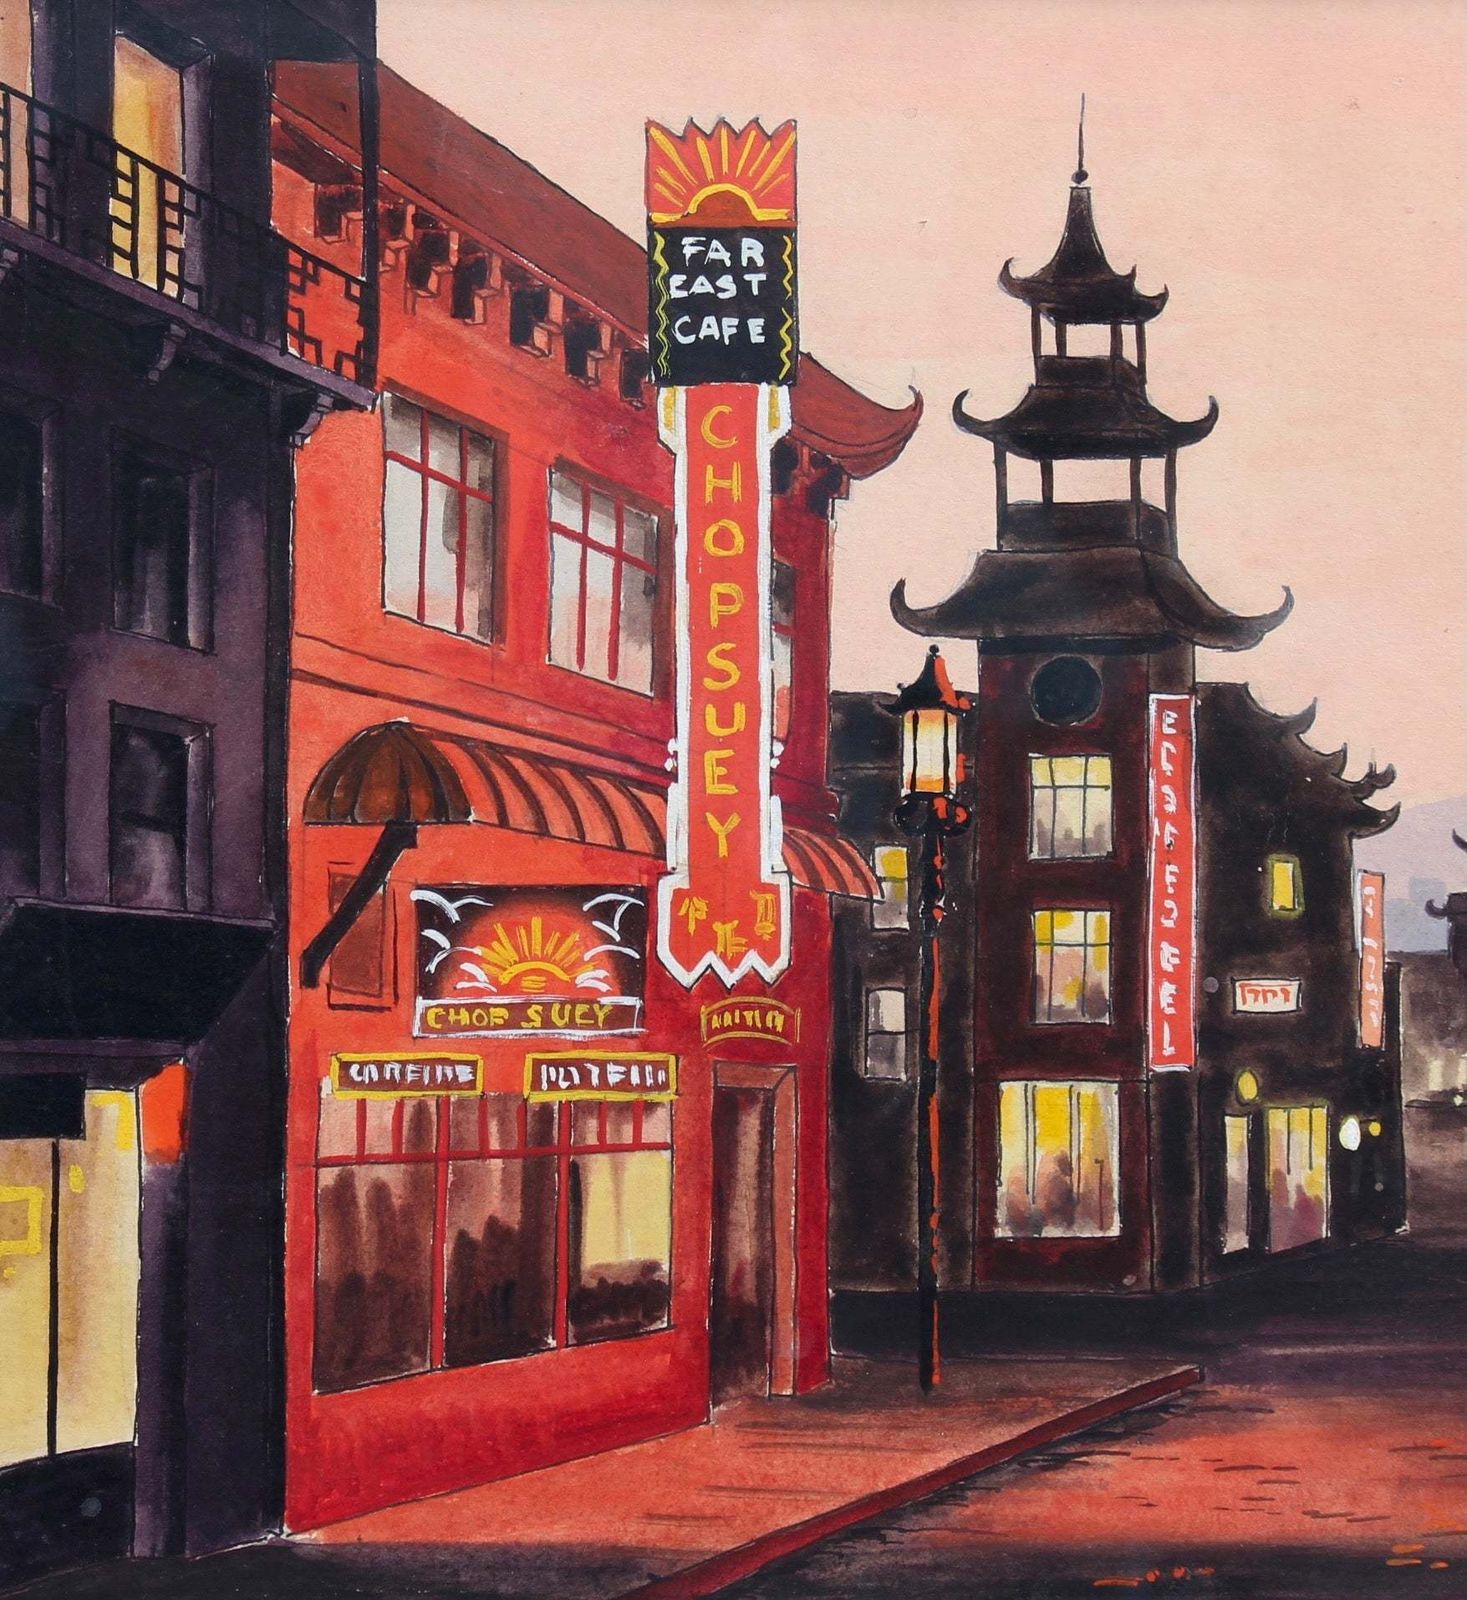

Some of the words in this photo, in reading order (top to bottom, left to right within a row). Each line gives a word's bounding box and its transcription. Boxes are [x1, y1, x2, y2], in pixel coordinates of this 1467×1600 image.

[681, 236, 765, 267] FAR
[668, 273, 767, 299] EAST
[672, 315, 766, 344] CAFE
[700, 404, 745, 629] CHOP
[703, 642, 746, 857] SUEY
[520, 1003, 613, 1029] SUEY
